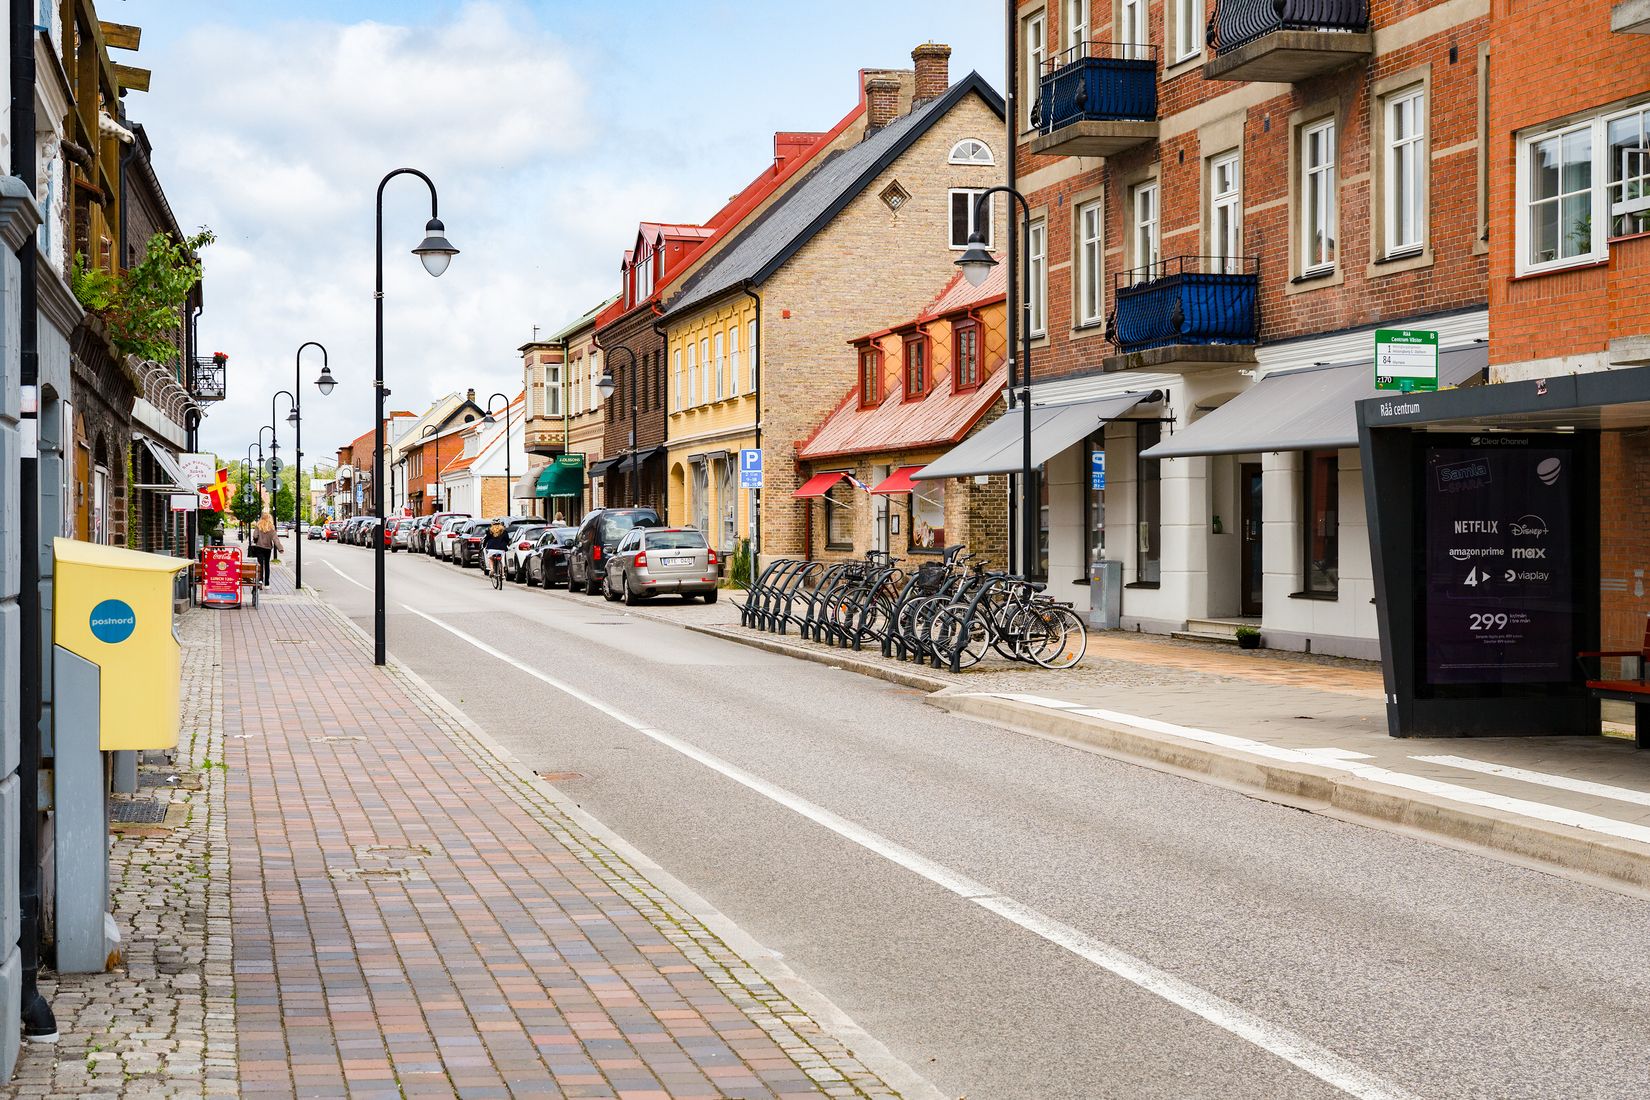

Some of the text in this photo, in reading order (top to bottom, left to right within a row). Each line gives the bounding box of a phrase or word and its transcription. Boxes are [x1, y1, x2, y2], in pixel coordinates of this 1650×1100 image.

[1382, 355, 1392, 365] 84
[1380, 402, 1420, 417] Råå centrum
[1481, 437, 1529, 445] Clear Channel
[745, 451, 759, 469] P
[1440, 463, 1487, 482] Samla
[1454, 520, 1549, 539] NETFLIX Disney+
[1449, 547, 1546, 559] amazon prime max
[1464, 565, 1549, 587] 4 viaplay
[91, 616, 134, 627] postnord
[1469, 613, 1508, 630] 299
